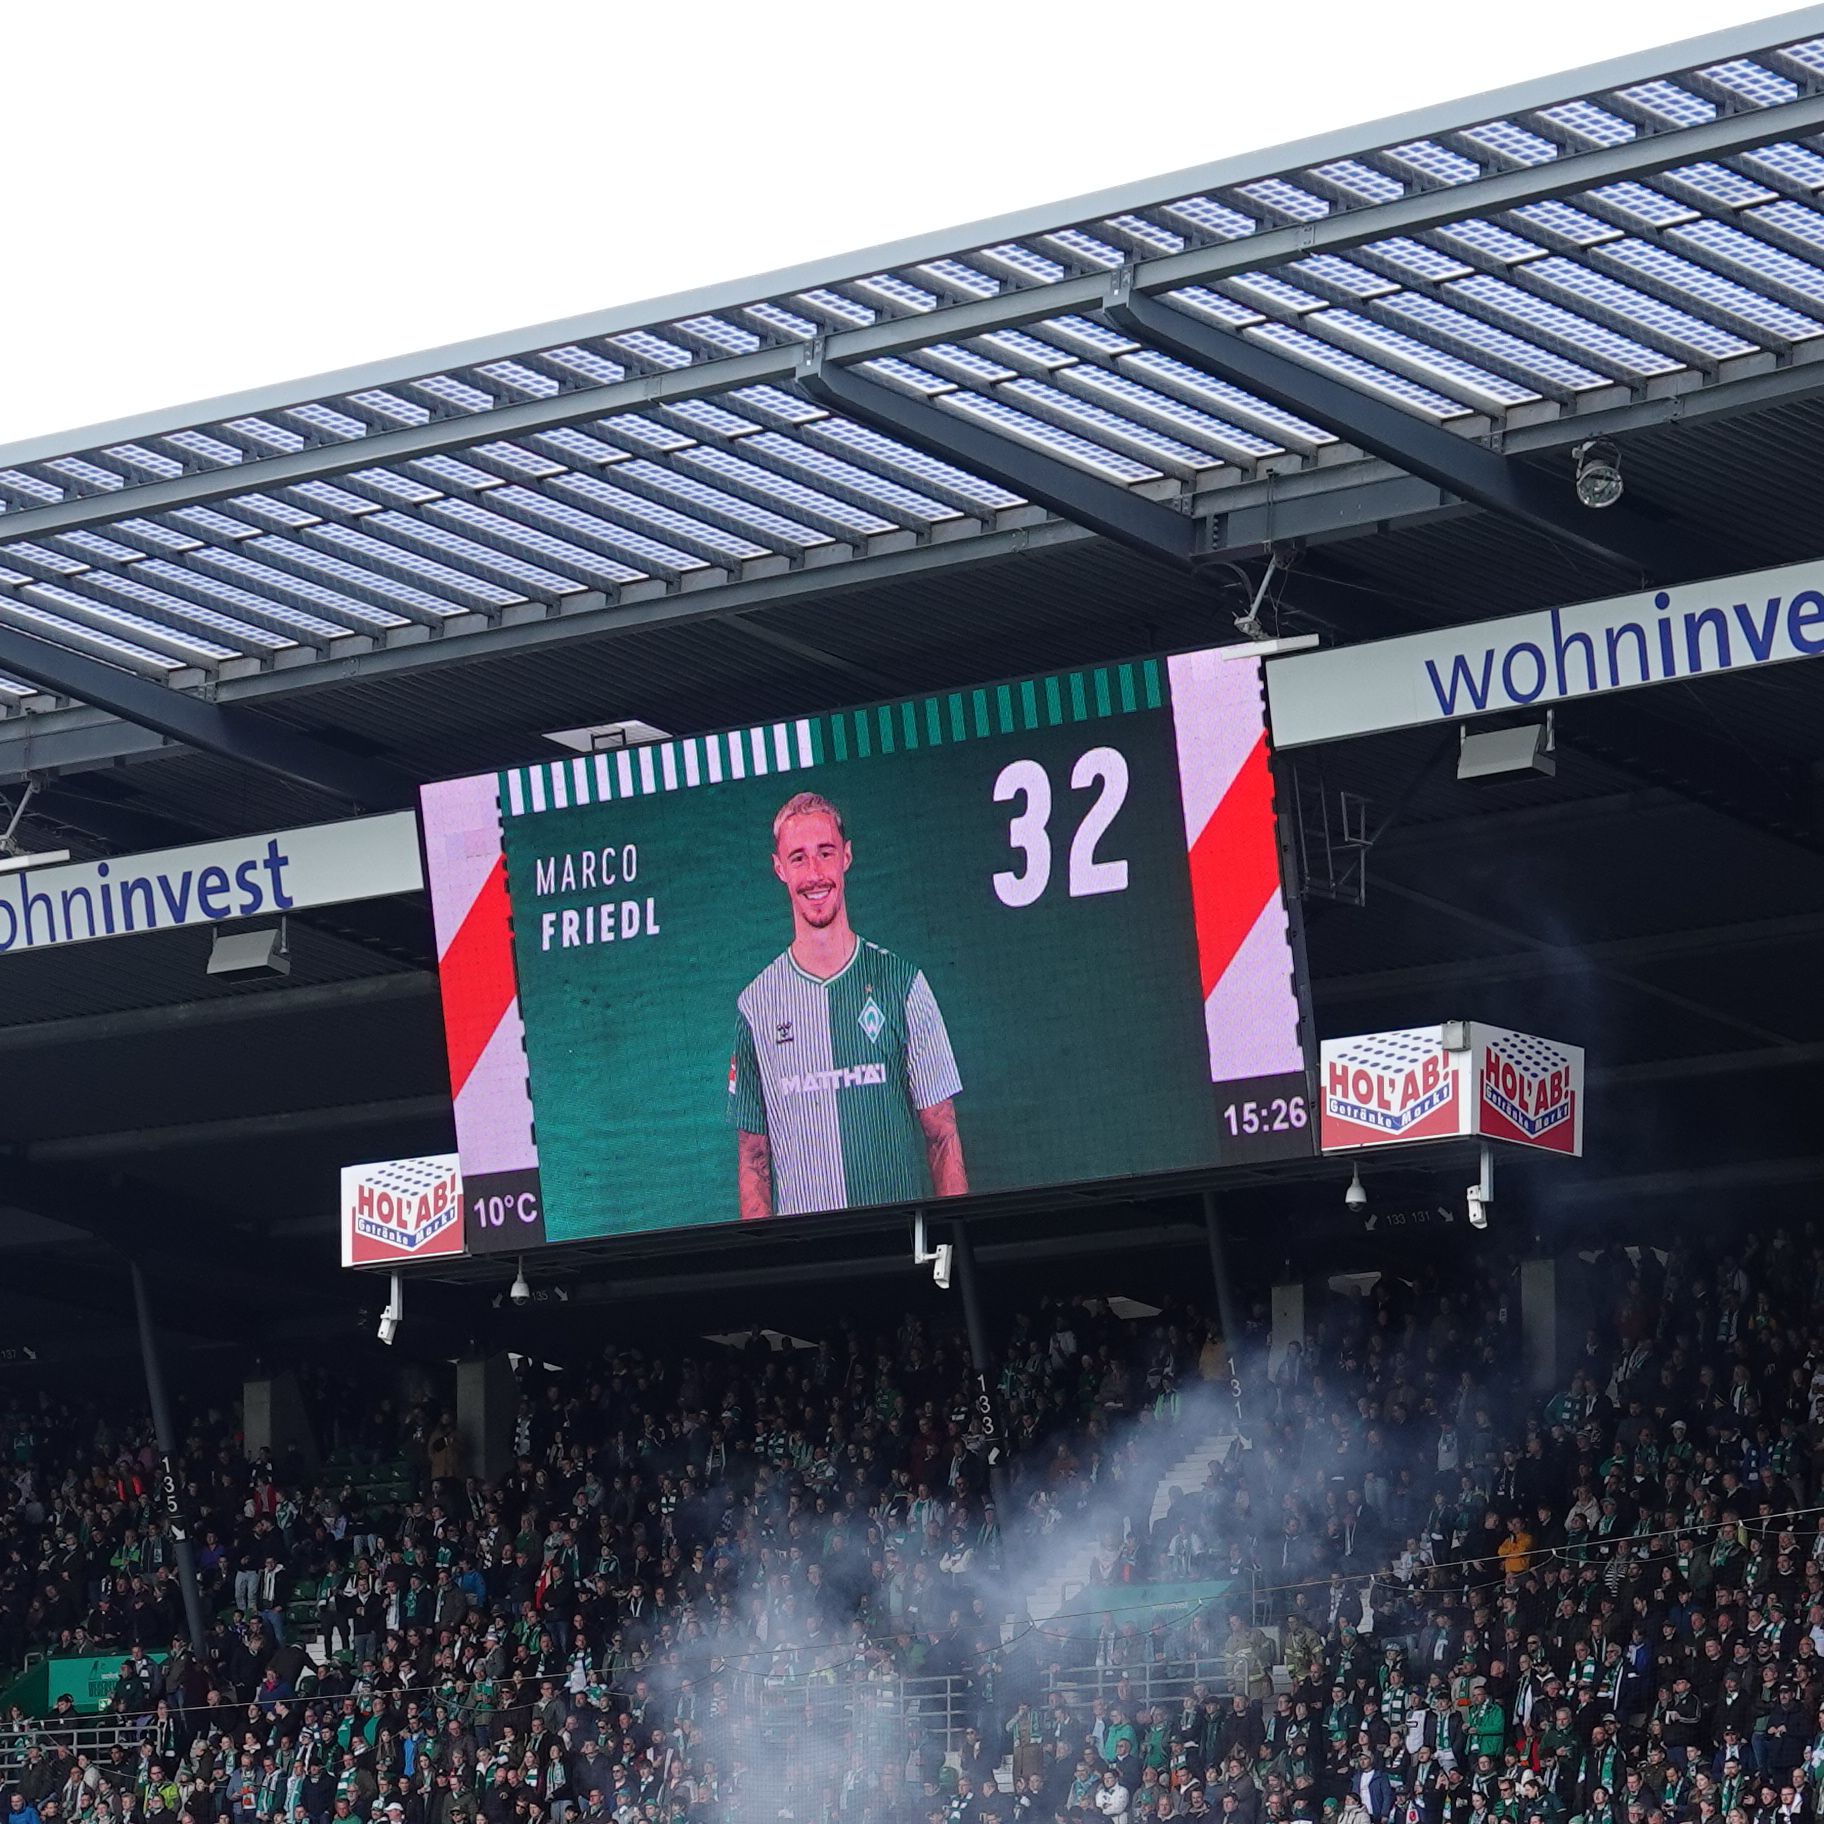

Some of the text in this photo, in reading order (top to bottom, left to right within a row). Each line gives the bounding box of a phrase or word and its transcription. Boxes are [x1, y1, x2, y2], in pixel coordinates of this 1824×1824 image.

[992, 746, 1129, 908] 32
[535, 844, 638, 896] MARCO
[541, 896, 661, 950] FRIEDL
[1330, 1082, 1450, 1128] Getränke Markt
[1486, 1046, 1570, 1117] HOL'AB!
[1223, 1095, 1308, 1137] 15:26
[1485, 1086, 1569, 1132] Getränke Markt
[358, 1172, 456, 1230] HOL'AB!
[358, 1206, 456, 1246] Getränke Markt
[474, 1193, 538, 1229] 10°C
[977, 1372, 994, 1435] 133
[1228, 1356, 1243, 1420] 131
[162, 1456, 178, 1513] 135
